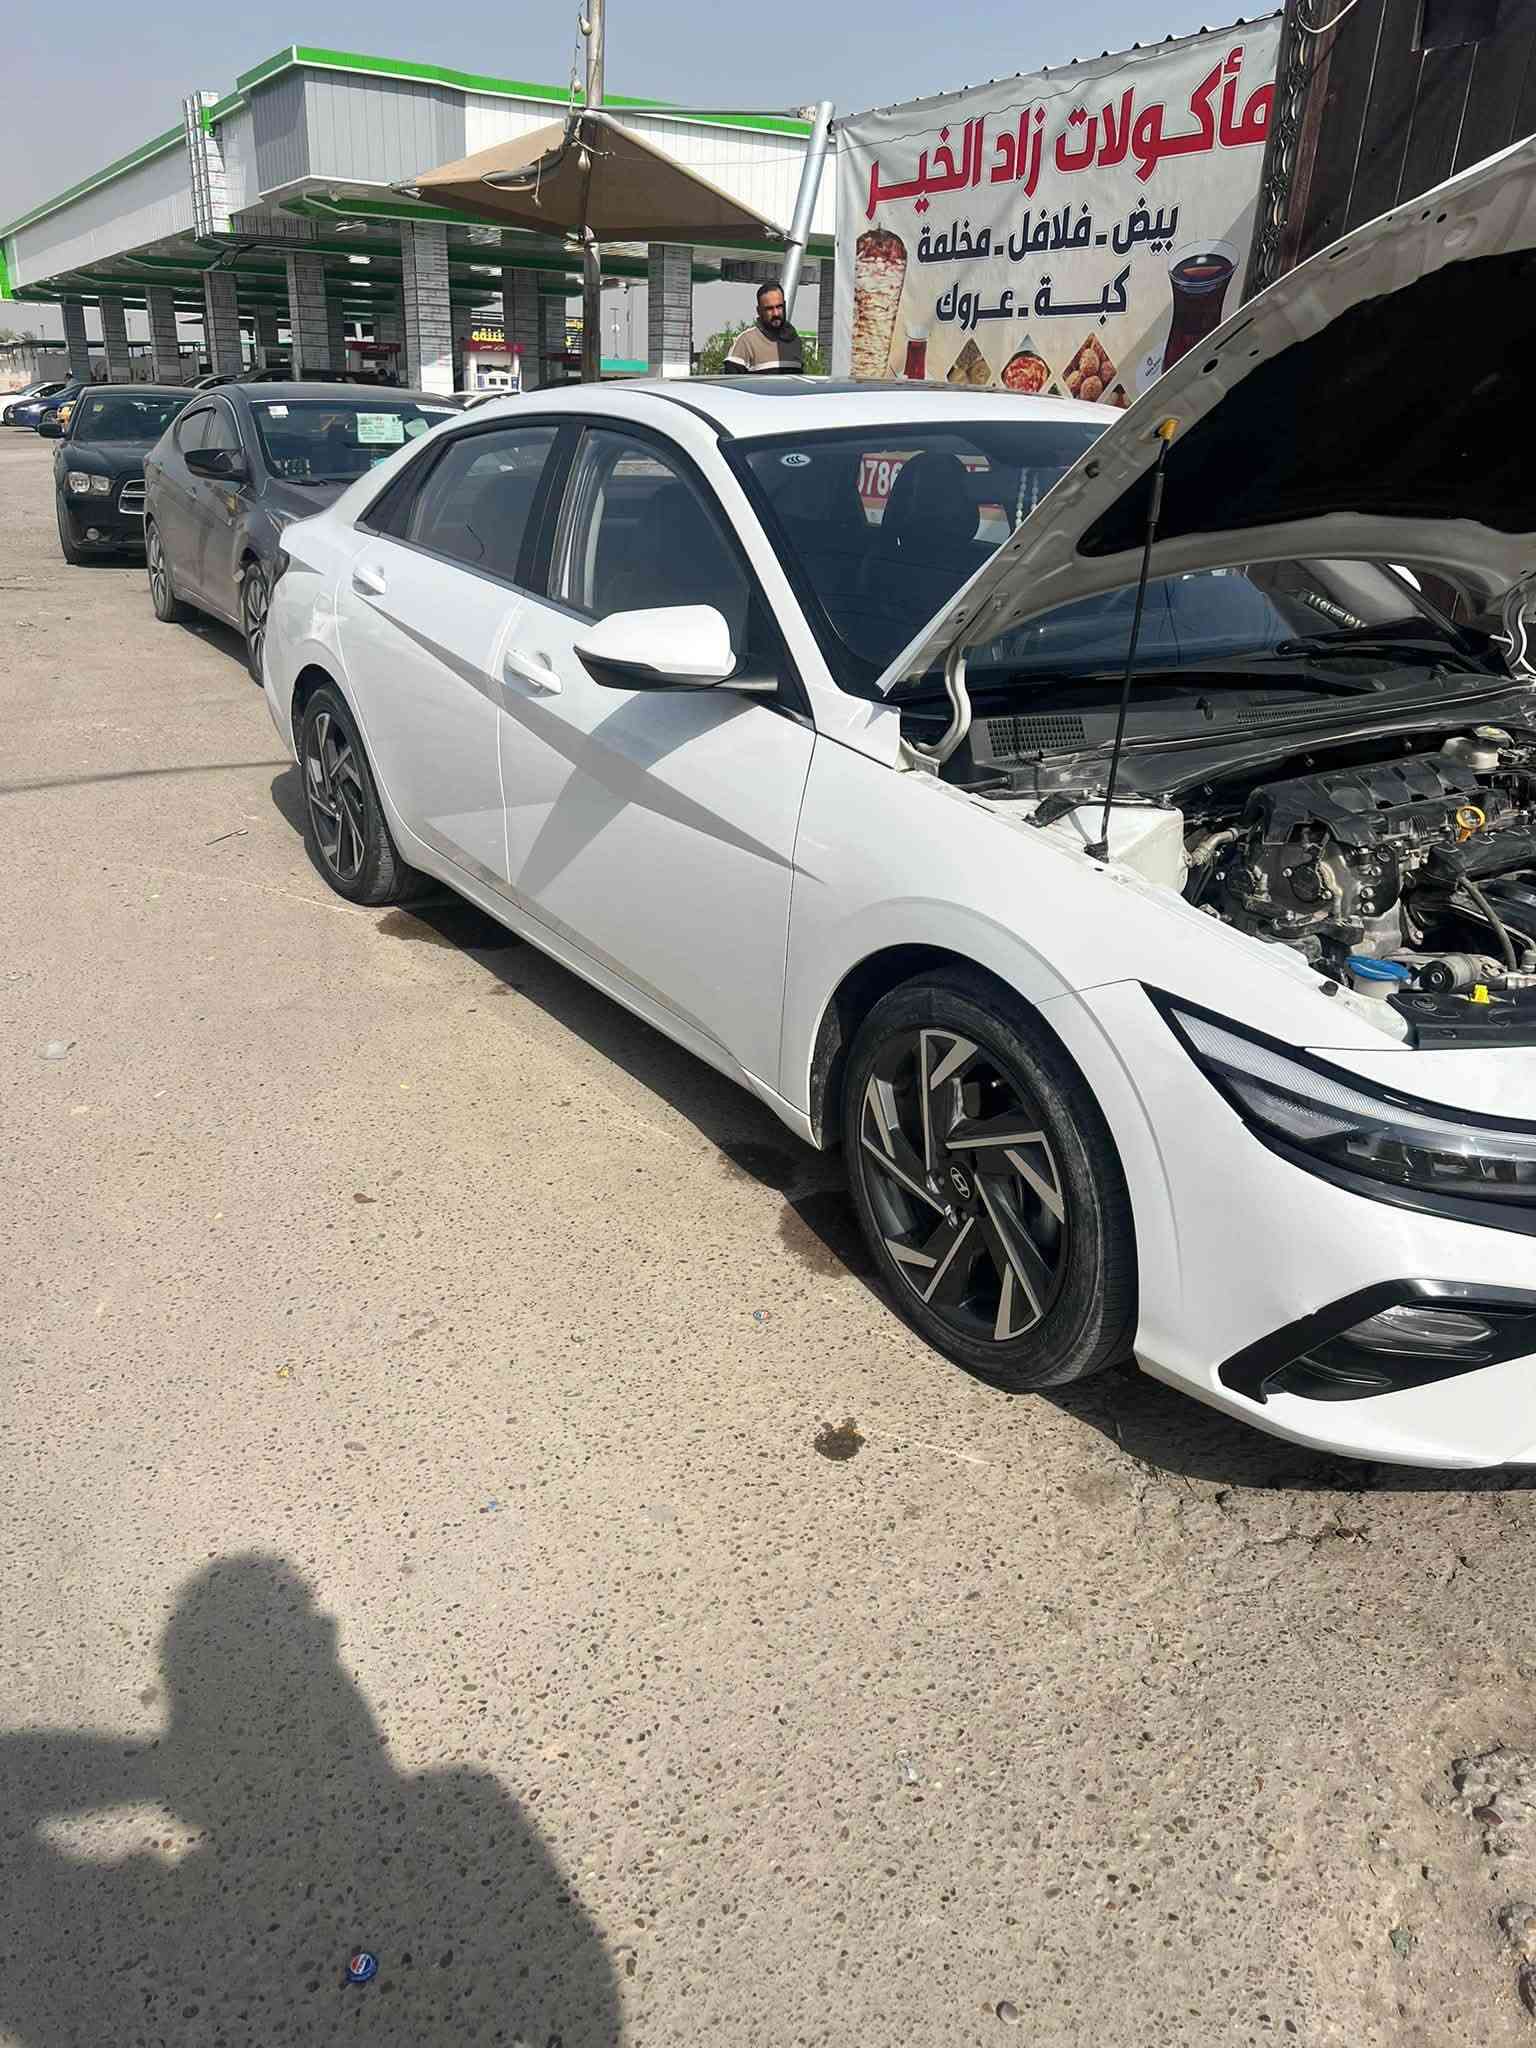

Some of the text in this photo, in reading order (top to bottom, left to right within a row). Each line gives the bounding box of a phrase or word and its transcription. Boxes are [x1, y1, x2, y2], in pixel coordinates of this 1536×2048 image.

[865, 46, 1276, 220] مأكولات زاد الخير
[918, 220, 991, 263] مخلمة
[1009, 203, 1092, 262] فلافل
[1113, 197, 1179, 255] بيض
[936, 282, 1013, 331] عروك
[1034, 264, 1131, 326] كبة
